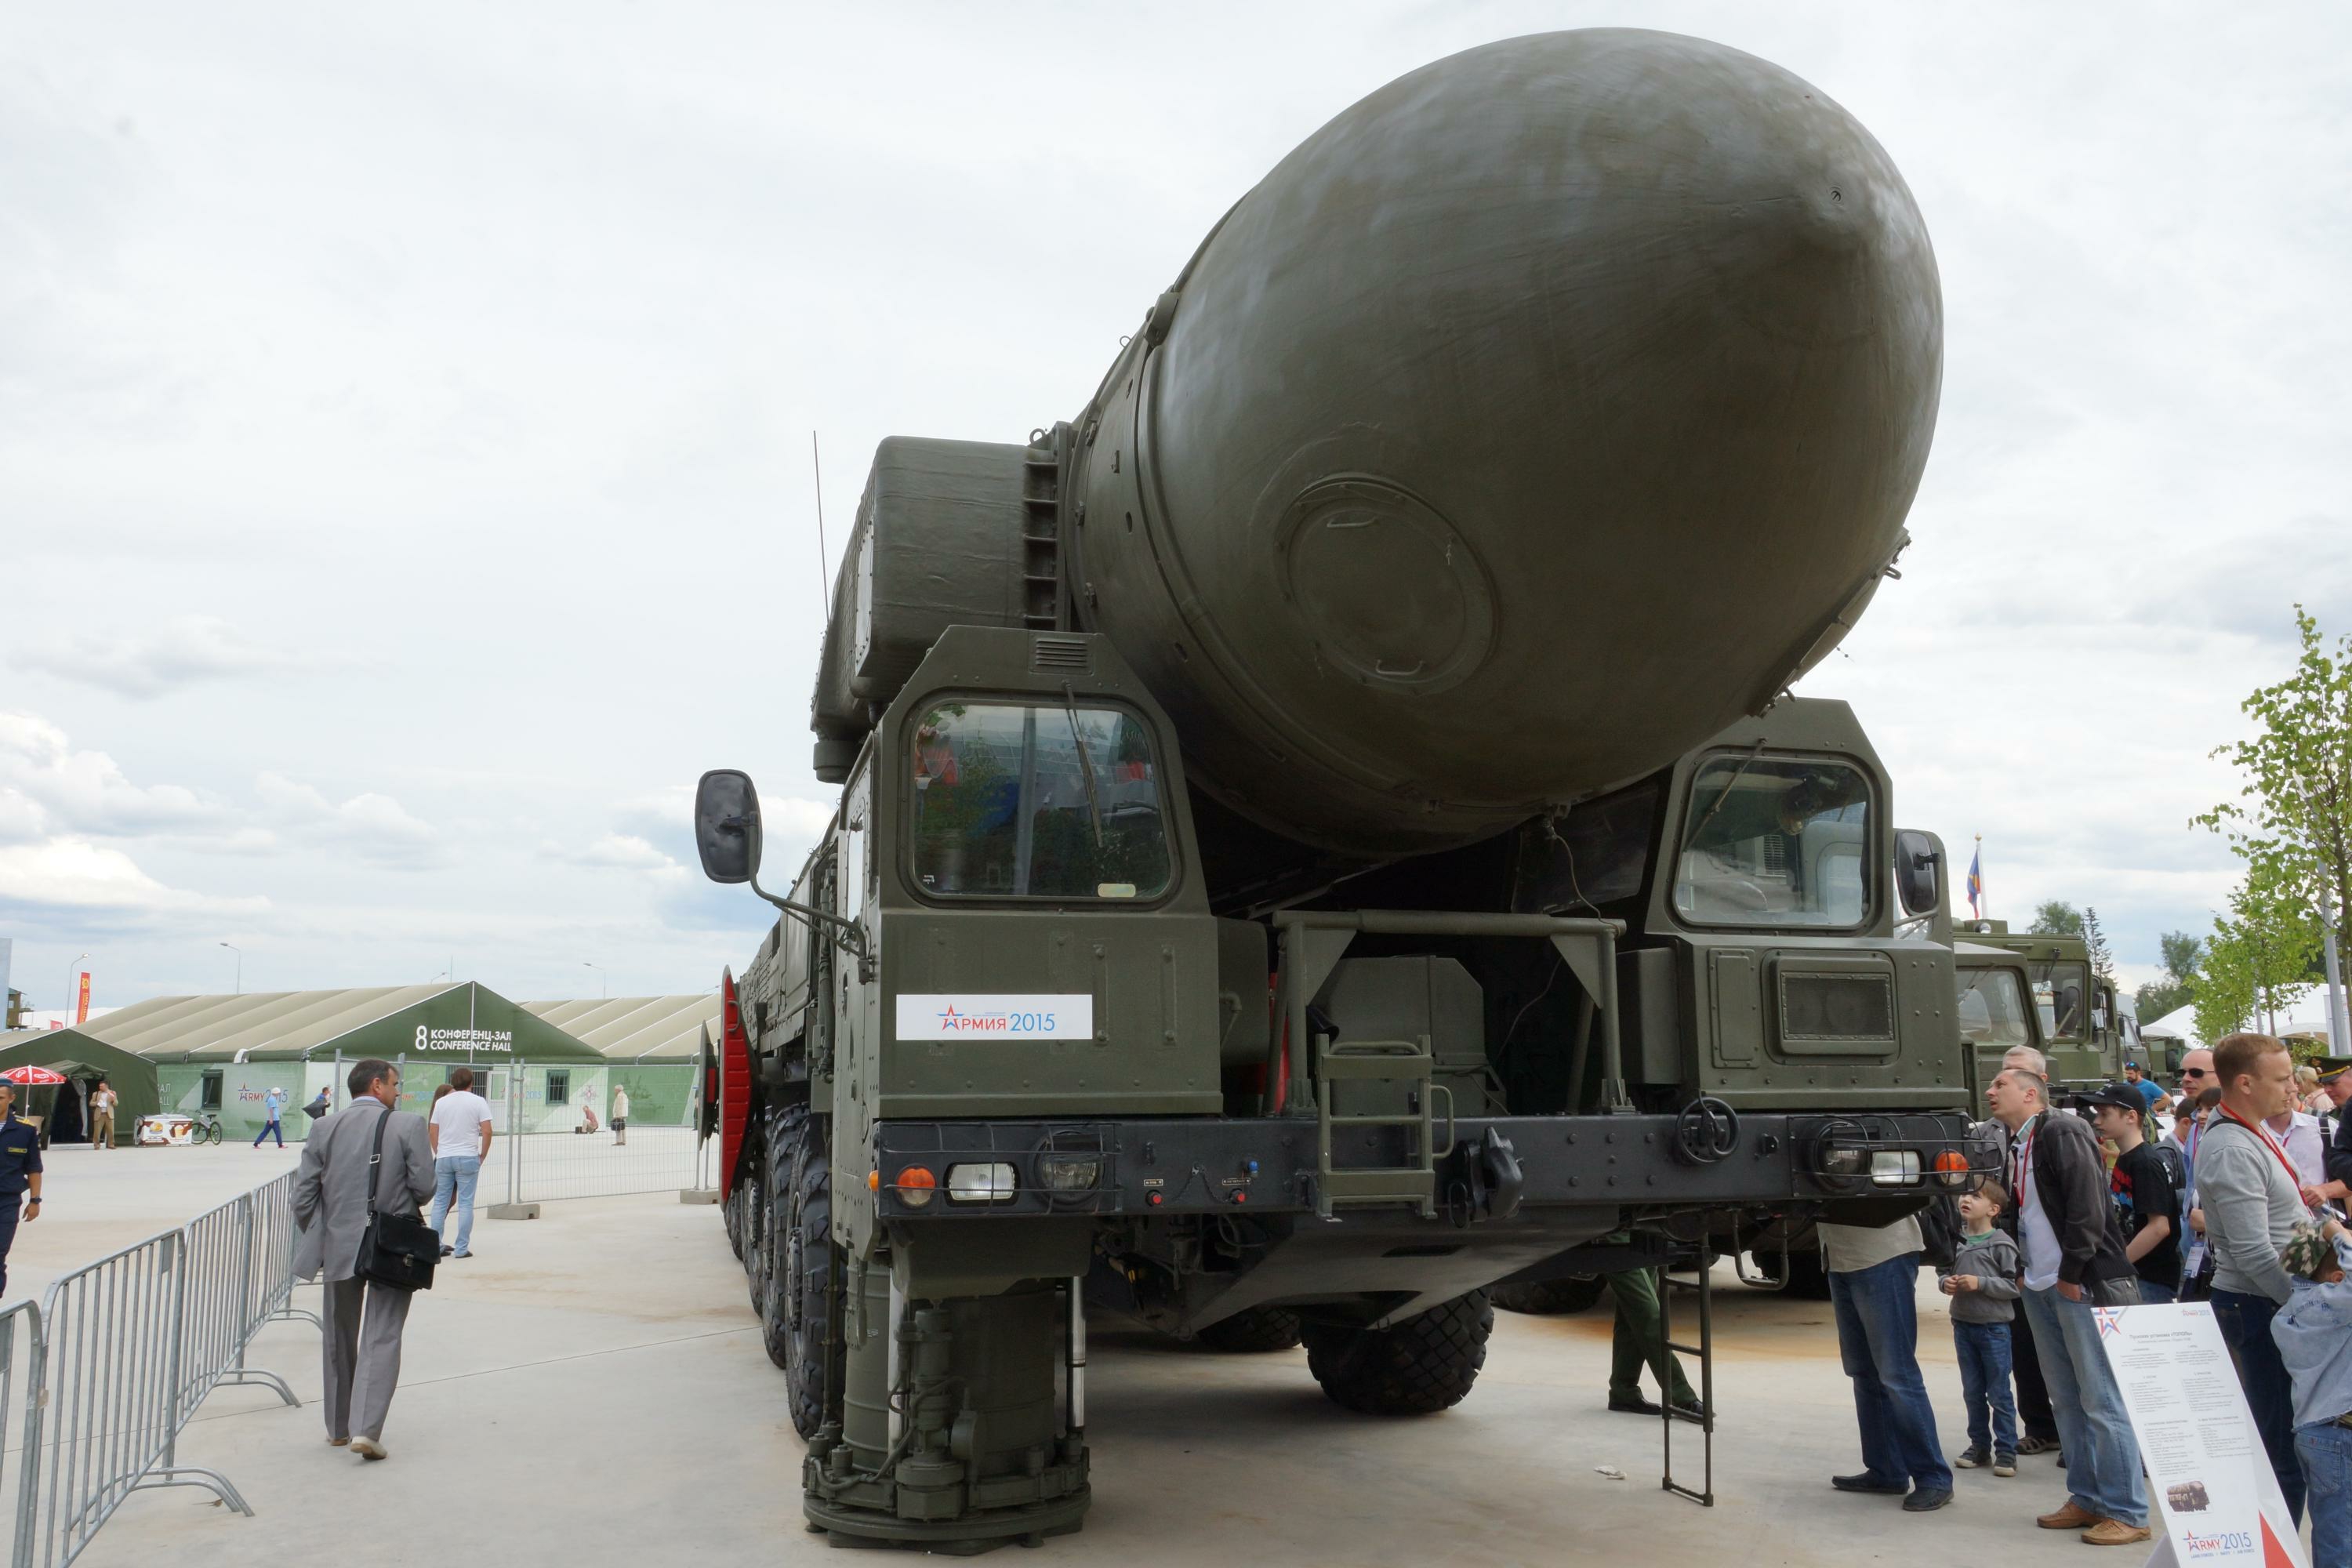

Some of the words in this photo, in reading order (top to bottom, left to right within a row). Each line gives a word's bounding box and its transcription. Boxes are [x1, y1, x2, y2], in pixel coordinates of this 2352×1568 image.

[937, 1004, 1006, 1031] АРМИЯ
[1010, 1013, 1055, 1032] 2015
[415, 1025, 427, 1051] 8
[430, 1029, 512, 1041] КОНФЕРЕНЦ-ЗАЛ
[430, 1040, 490, 1051] CONFERENCE
[492, 1042, 512, 1051] HALL
[238, 1082, 265, 1102] ARMY
[265, 1088, 289, 1103] 215
[2183, 1530, 2220, 1552] ARMY
[2220, 1532, 2252, 1549] 2015
